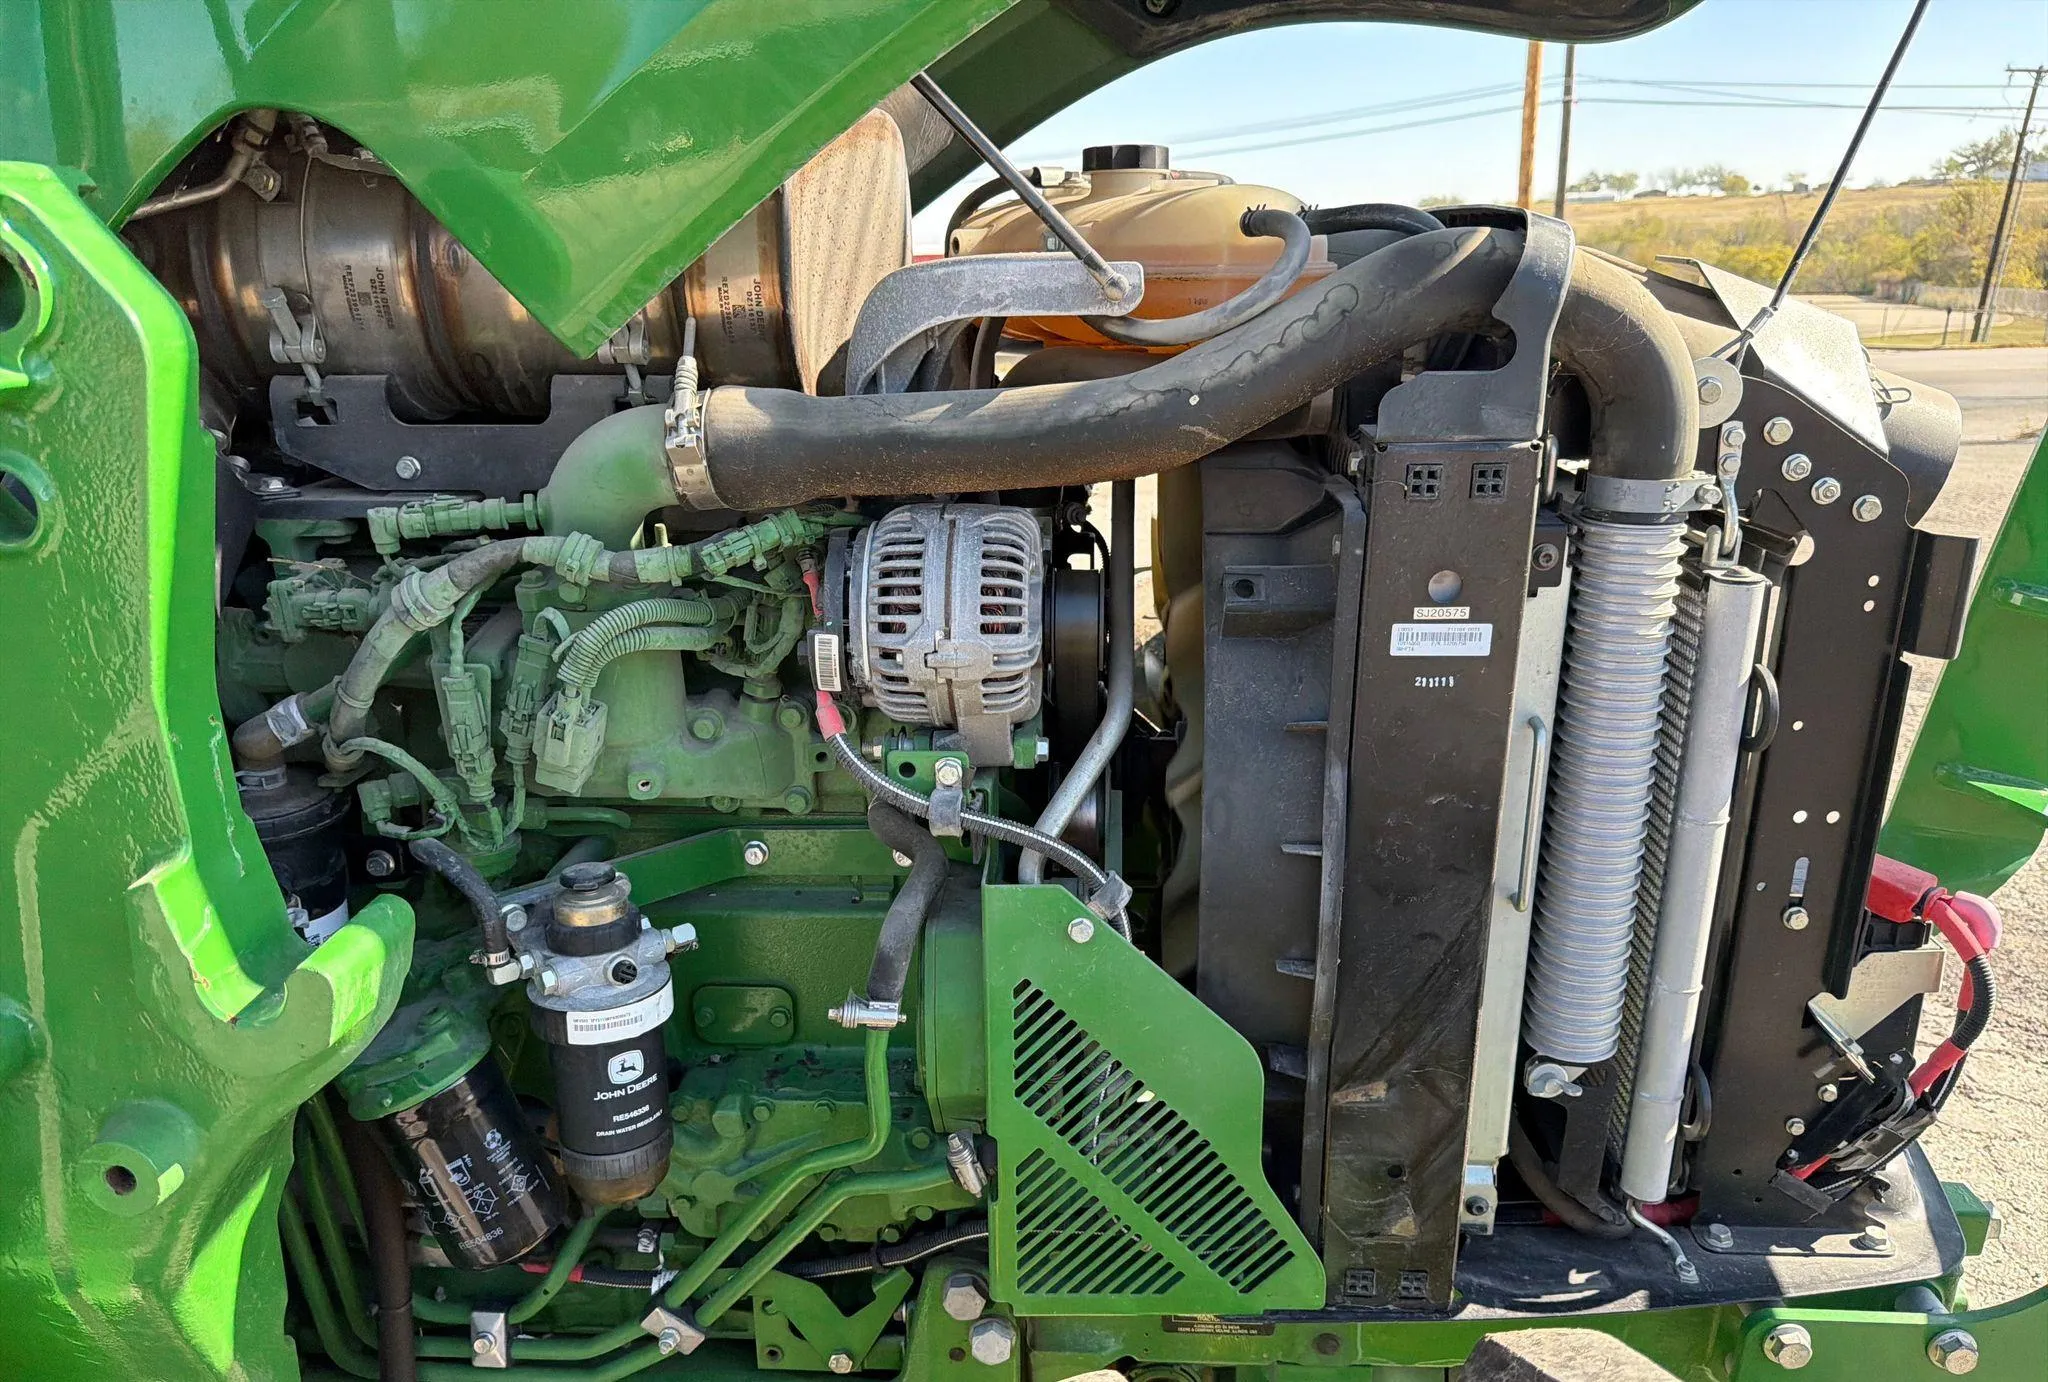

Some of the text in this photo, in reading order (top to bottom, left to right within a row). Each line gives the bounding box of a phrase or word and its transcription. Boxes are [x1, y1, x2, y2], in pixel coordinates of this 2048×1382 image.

[376, 267, 387, 295] JOHN
[753, 279, 762, 307] JOHN
[1416, 608, 1467, 618] SJ20575
[593, 1073, 658, 1101] JOHN DEERE
[596, 1129, 615, 1137] DRAIN
[616, 1124, 637, 1134] WATER
[458, 1227, 503, 1249] RE504836
